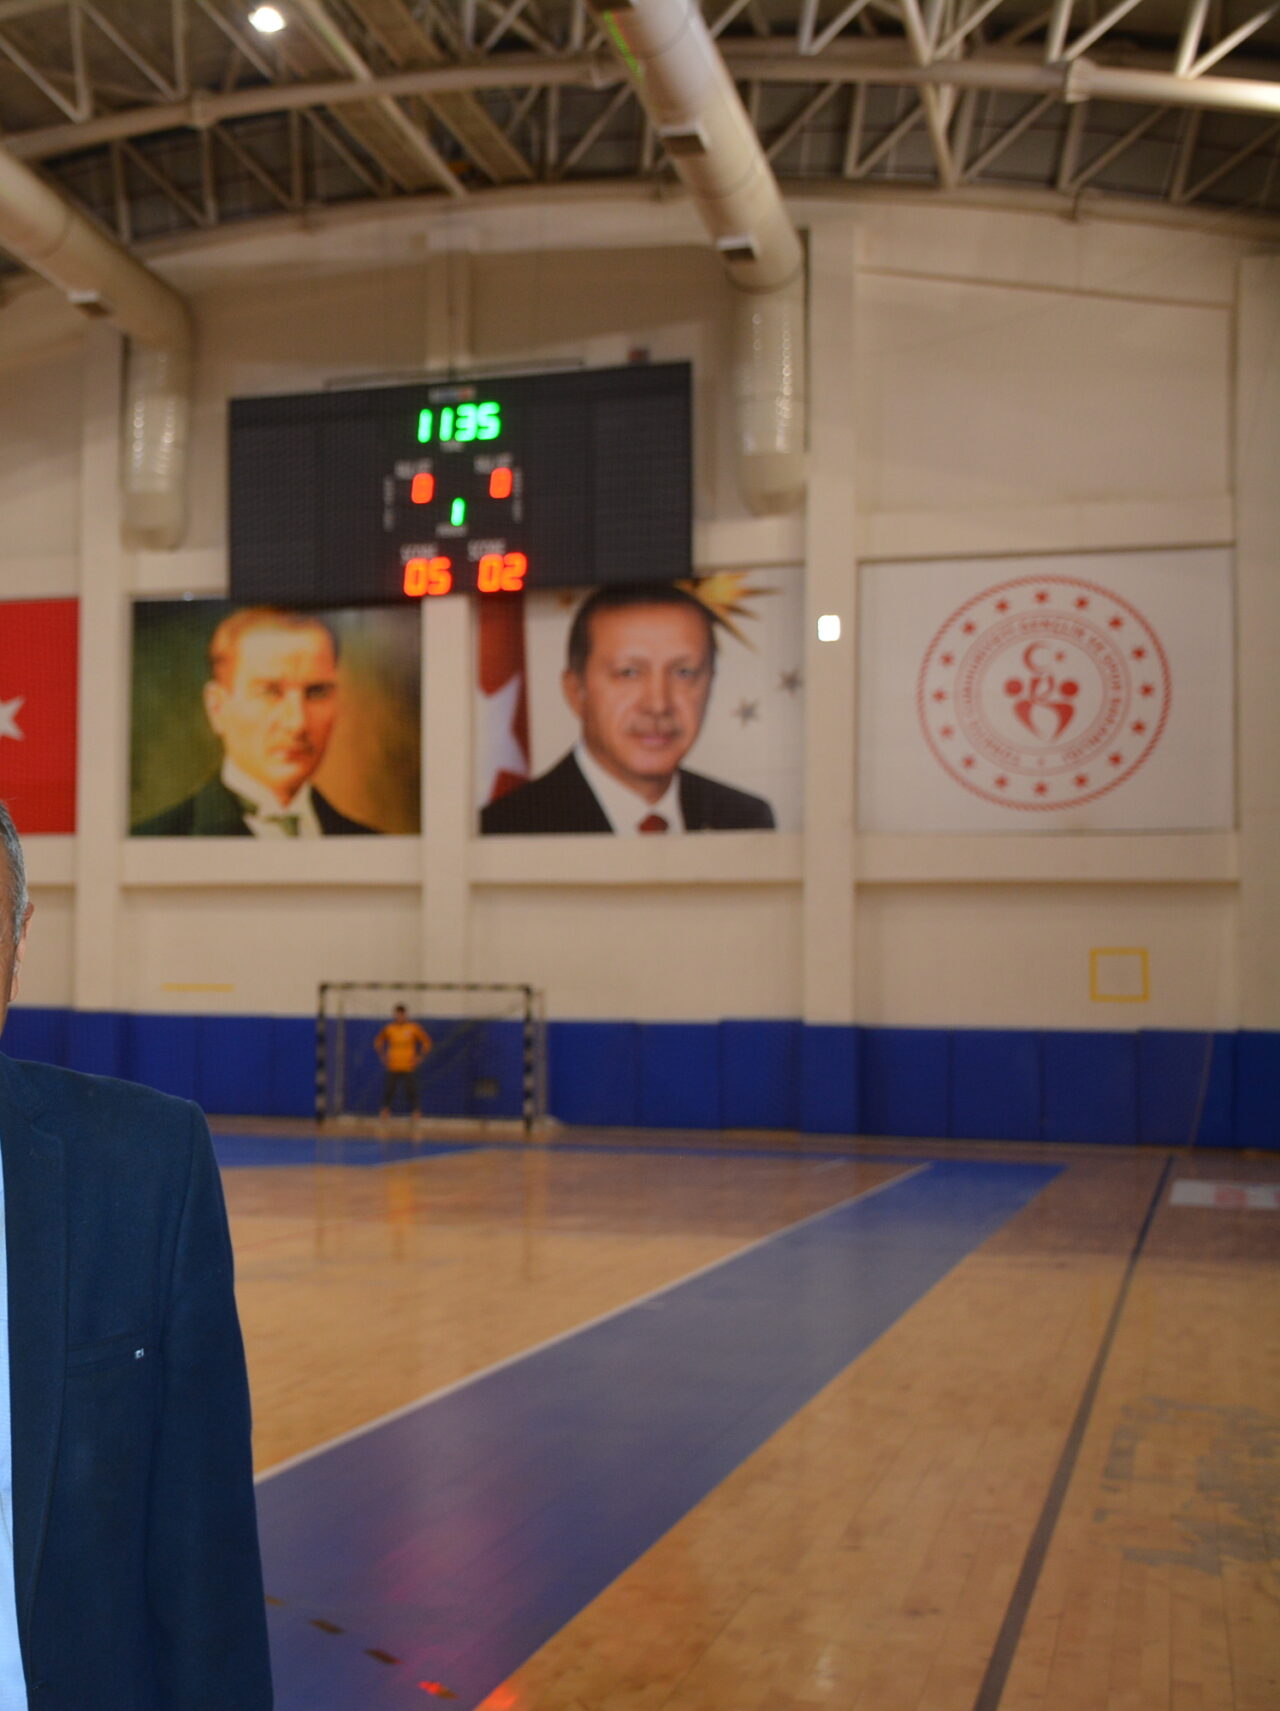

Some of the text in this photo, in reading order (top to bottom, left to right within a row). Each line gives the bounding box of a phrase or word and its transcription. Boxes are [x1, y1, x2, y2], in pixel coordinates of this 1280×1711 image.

[450, 497, 467, 527] 1
[403, 556, 453, 597] 05
[477, 552, 528, 593] 02
